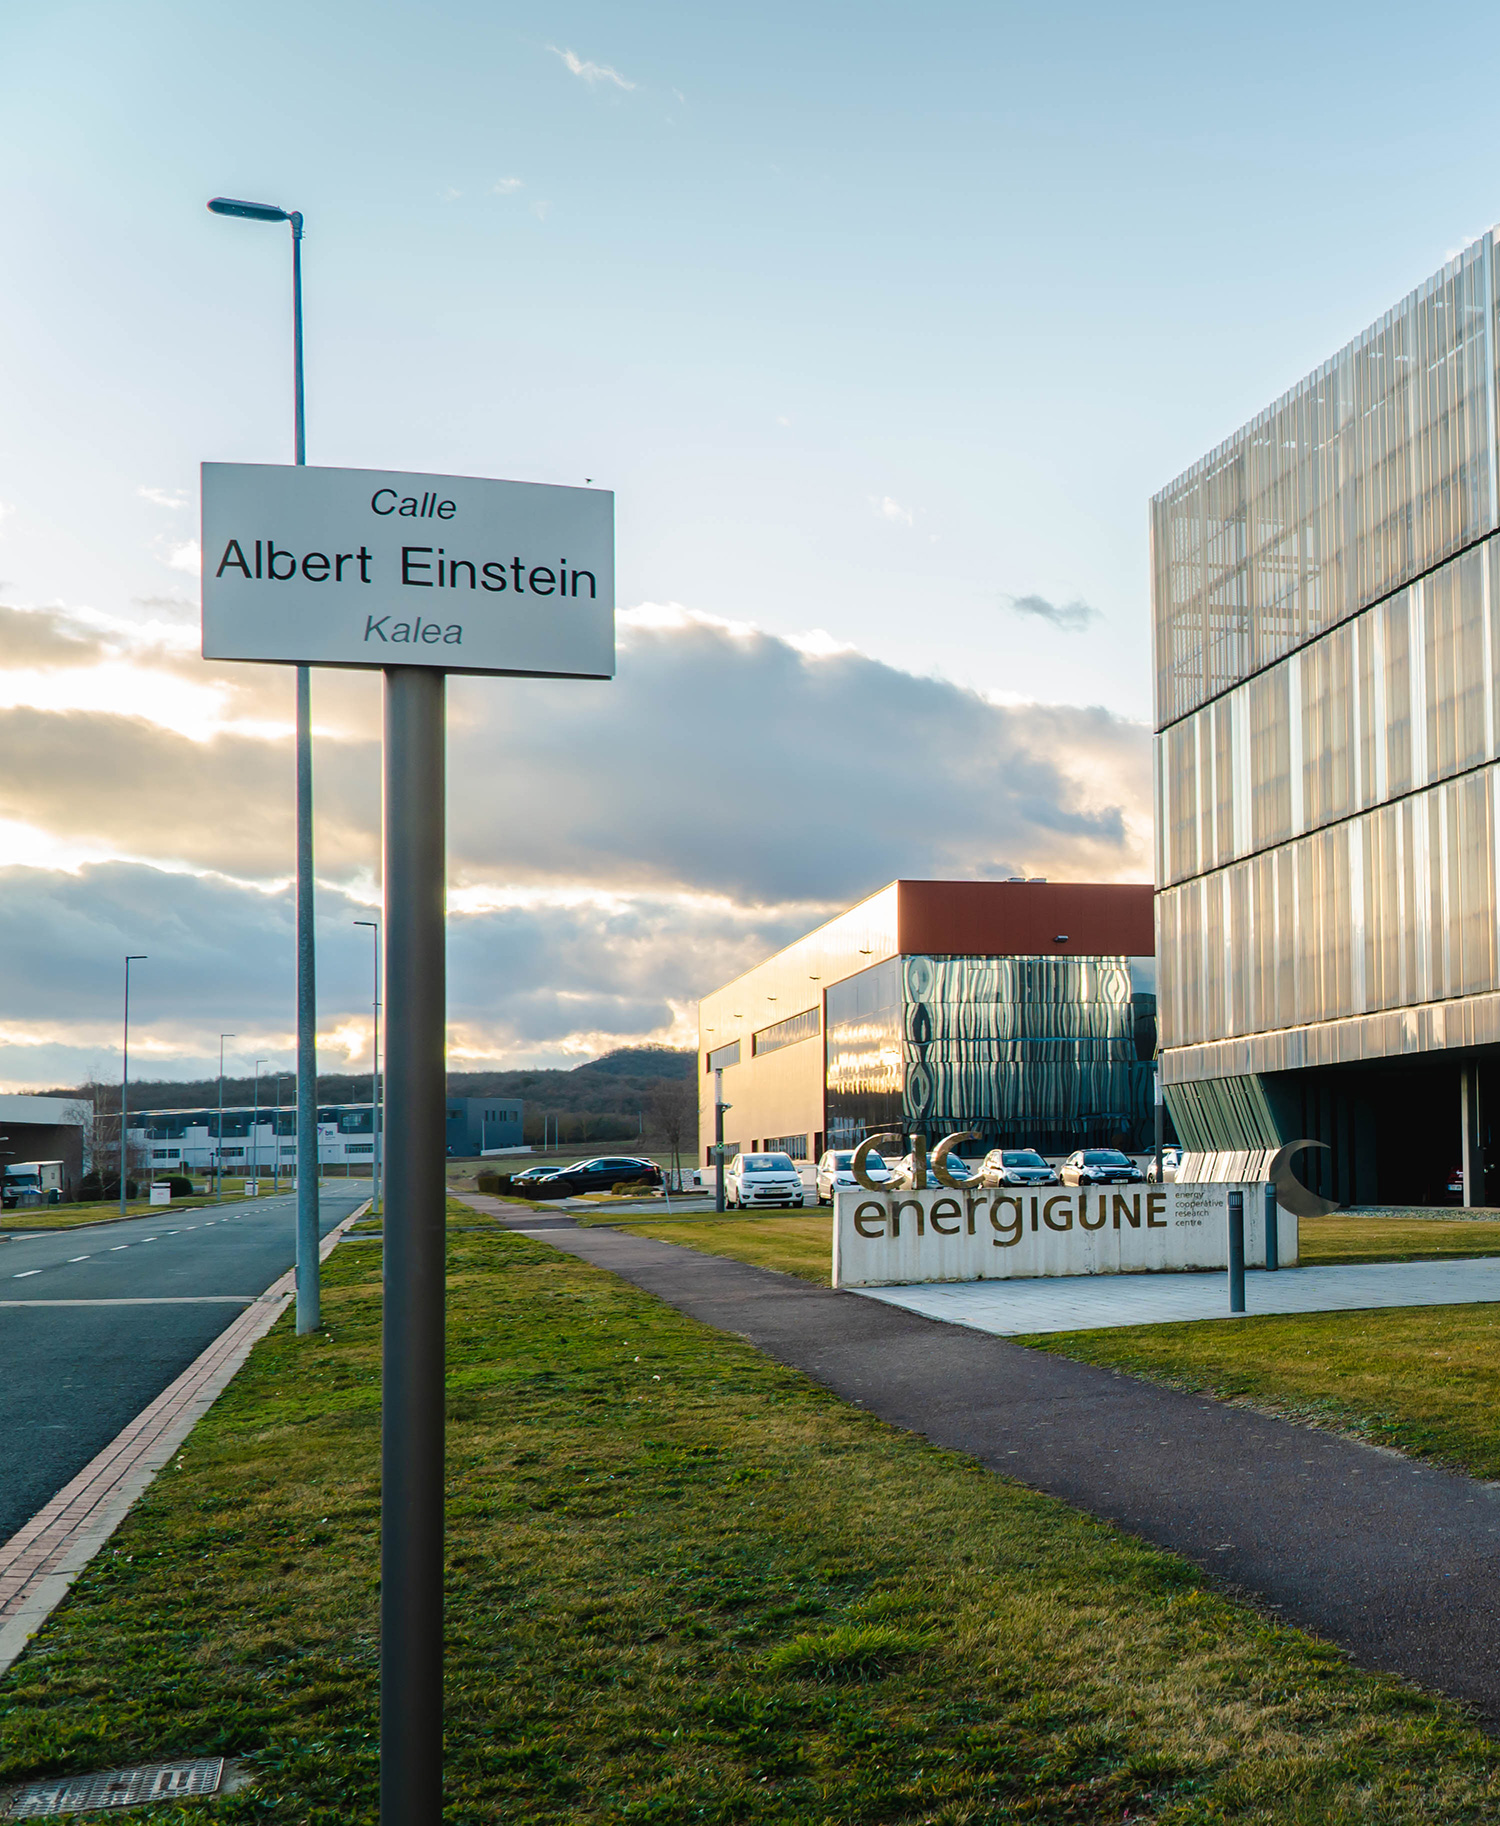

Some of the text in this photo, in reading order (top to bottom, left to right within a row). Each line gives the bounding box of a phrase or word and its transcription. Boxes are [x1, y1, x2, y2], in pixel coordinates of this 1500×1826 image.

[370, 488, 457, 520] Calle
[215, 539, 597, 599] Albert Einstein
[363, 615, 463, 645] Kalea
[1175, 1200, 1223, 1208] cooperative
[1175, 1209, 1209, 1217] research
